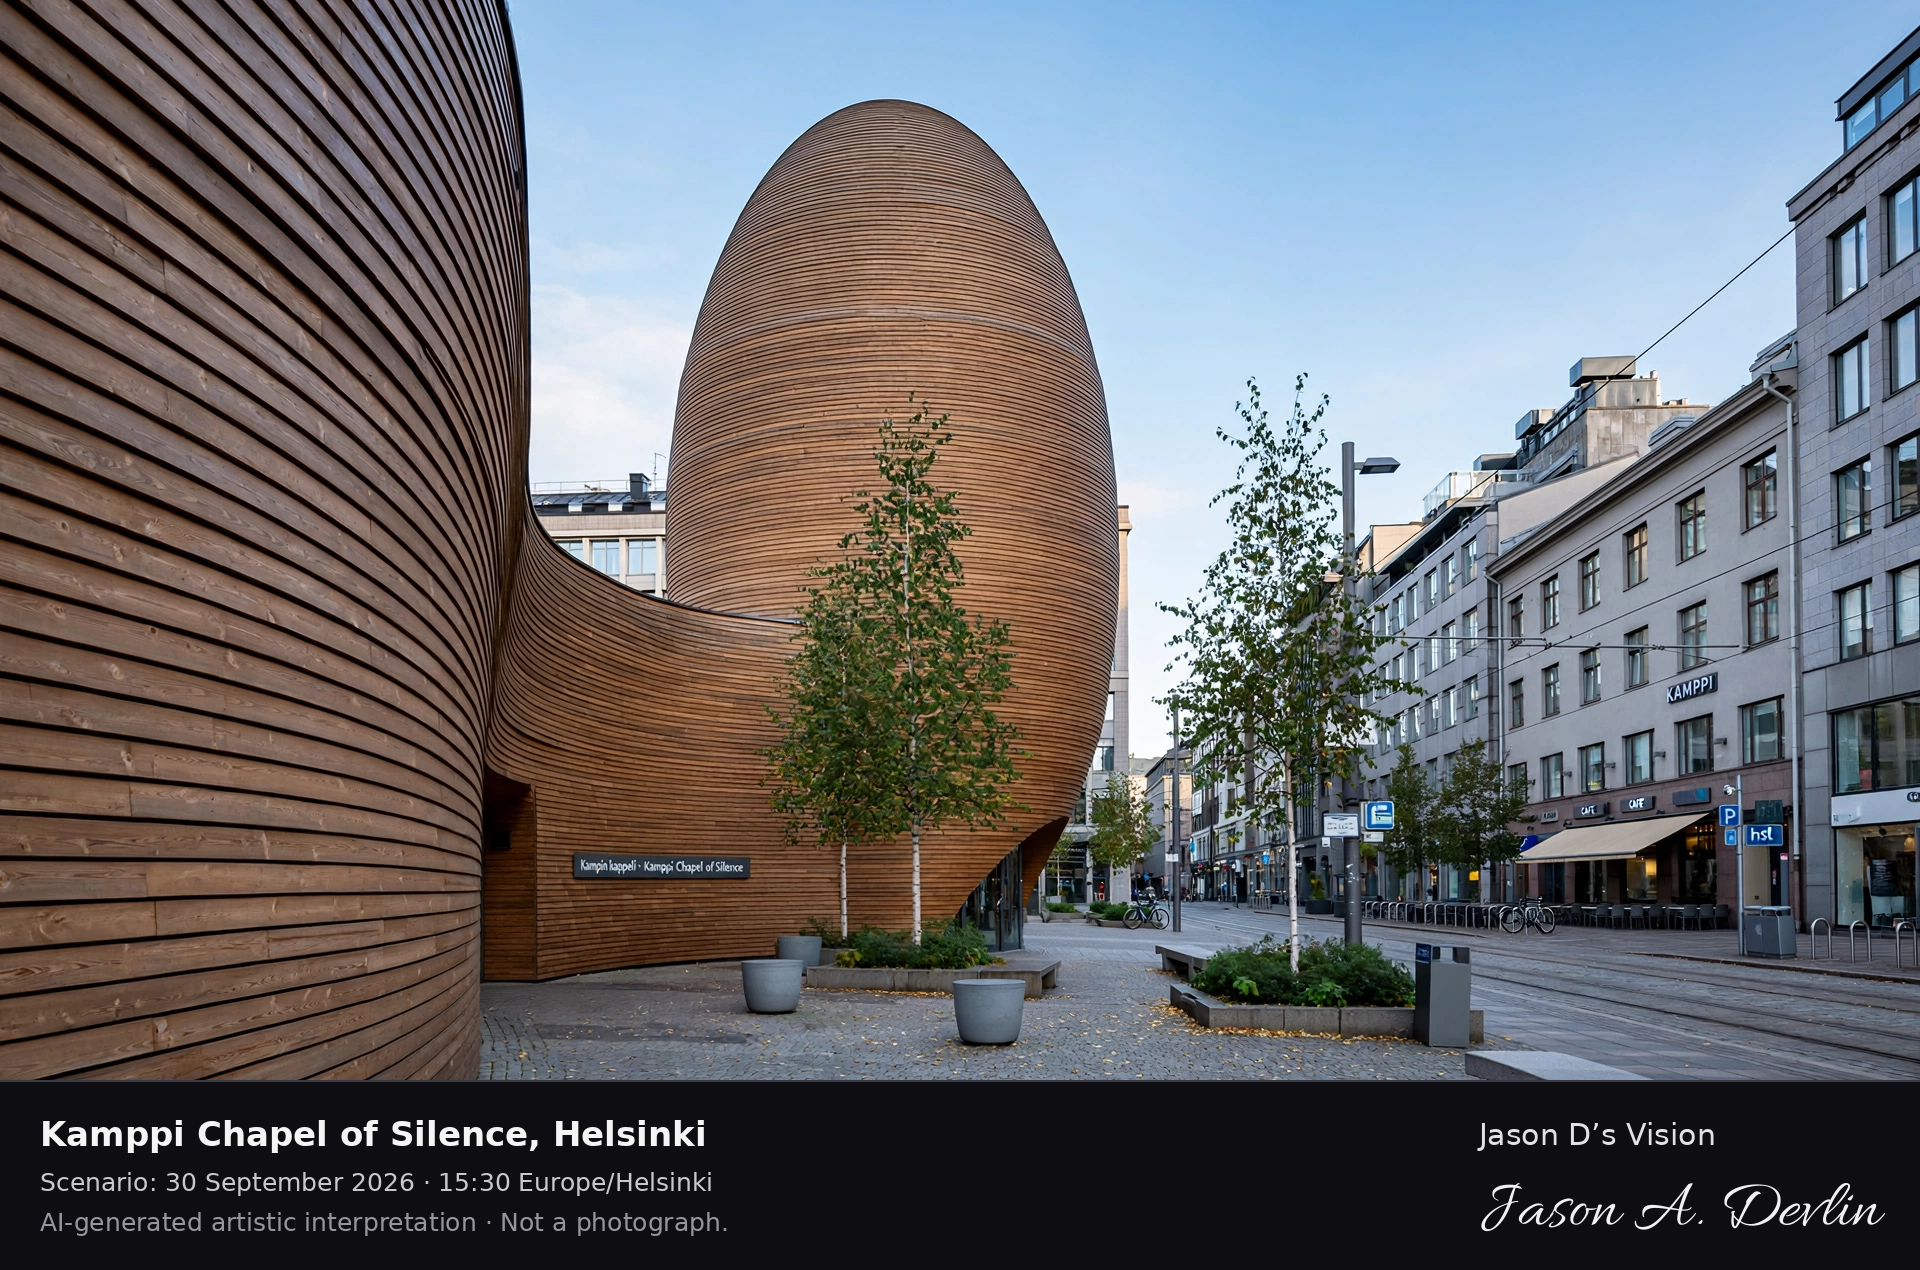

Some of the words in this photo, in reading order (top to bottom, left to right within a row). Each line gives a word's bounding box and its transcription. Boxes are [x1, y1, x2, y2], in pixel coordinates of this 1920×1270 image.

[1667, 676, 1713, 703] KAMPPI
[1725, 808, 1736, 825] P
[1750, 826, 1774, 842] hsl
[580, 859, 608, 875] Kampin
[644, 860, 674, 875] Kamppi
[676, 860, 704, 875] Chapel
[705, 861, 715, 872] of
[715, 861, 744, 873] Silence
